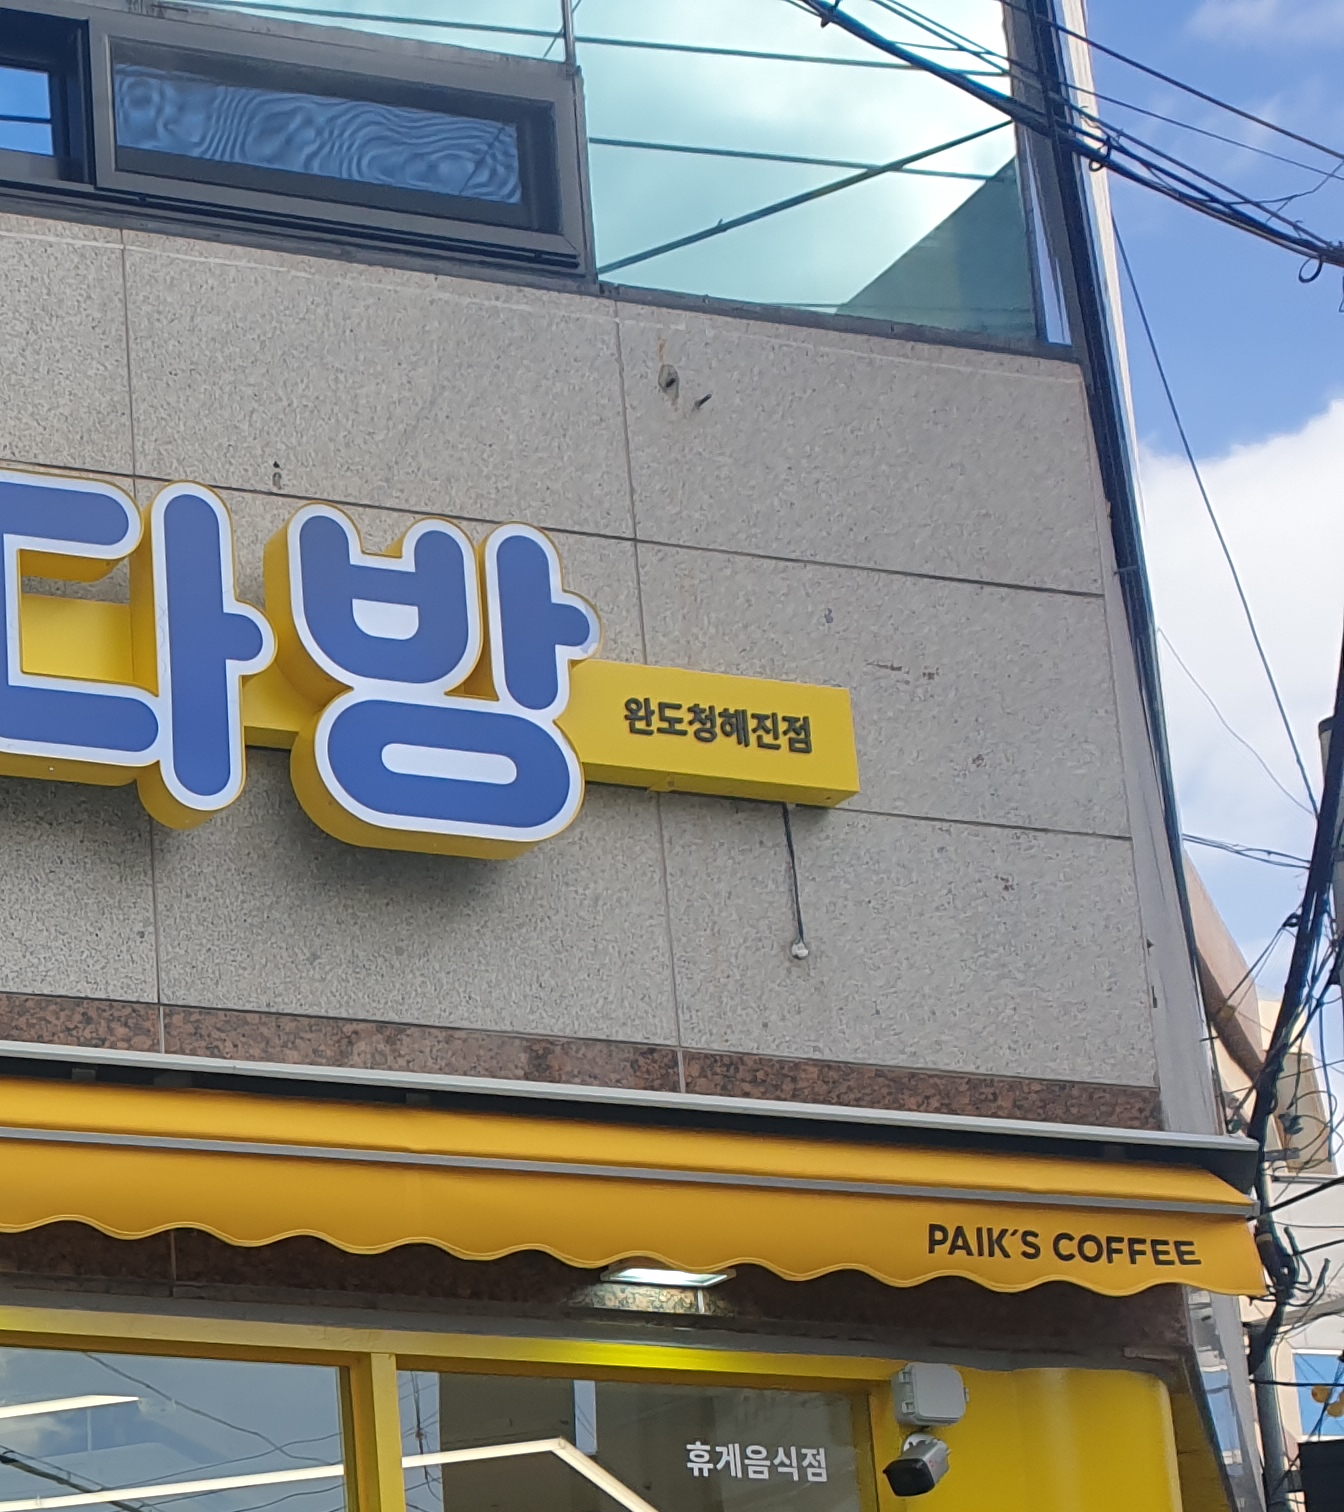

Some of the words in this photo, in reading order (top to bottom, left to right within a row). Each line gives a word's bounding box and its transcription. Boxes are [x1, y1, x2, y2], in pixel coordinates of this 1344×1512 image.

[624, 697, 812, 754] 완도청해진점
[927, 1223, 1041, 1260] PAIK'S
[1053, 1232, 1202, 1266] COFFEE
[686, 1441, 828, 1482] 휴게음식점
